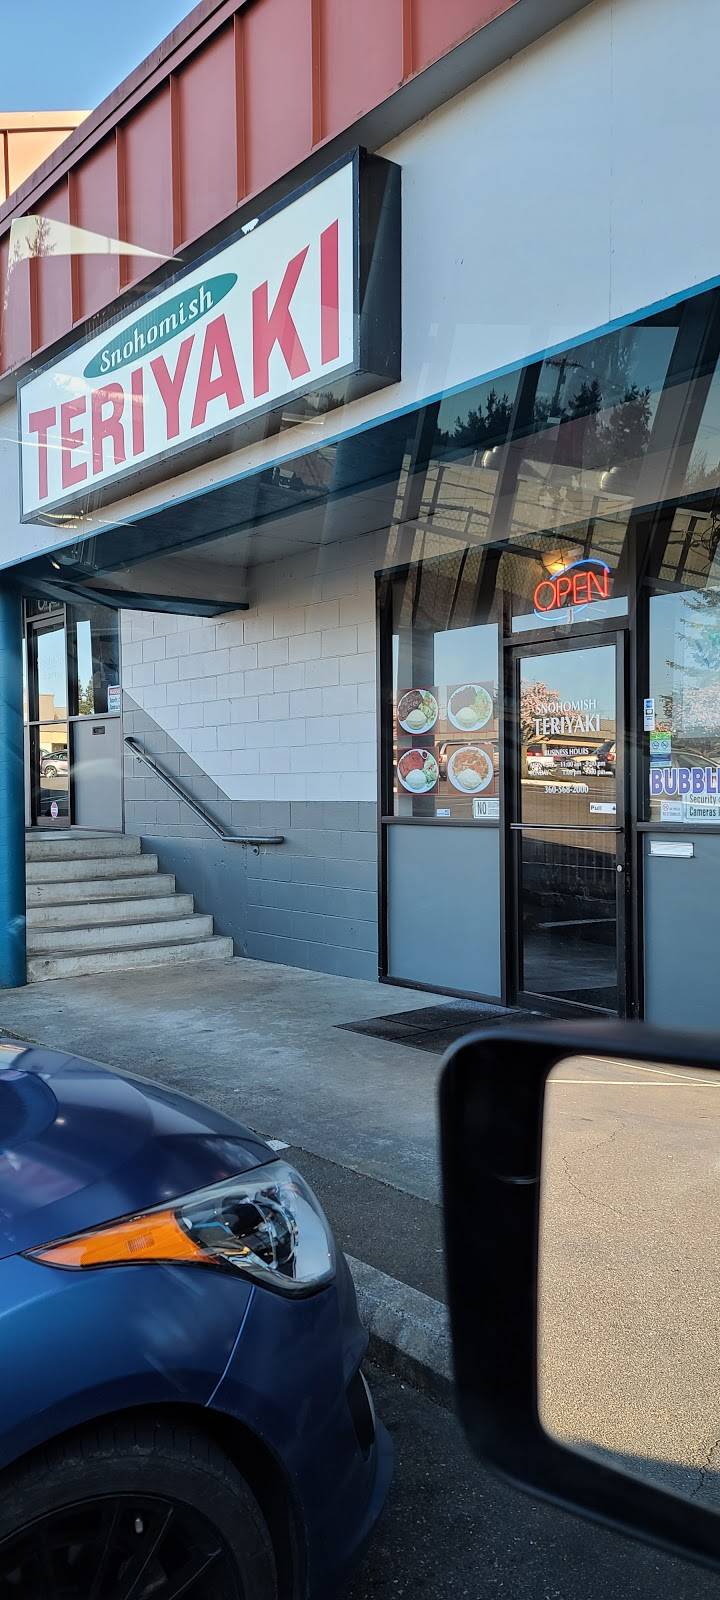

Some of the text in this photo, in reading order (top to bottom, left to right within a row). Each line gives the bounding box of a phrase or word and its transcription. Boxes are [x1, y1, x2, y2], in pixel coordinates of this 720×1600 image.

[99, 285, 214, 374] Snohomish
[28, 217, 340, 501] TERIYAKI
[533, 567, 609, 611] OPEN
[535, 698, 597, 715] SNOHOMISH
[532, 713, 602, 736] TERIYAKI
[544, 747, 589, 756] BUSINESS HOURS
[477, 801, 487, 815] NO
[689, 794, 718, 805] Security
[689, 806, 717, 817] Cameras
